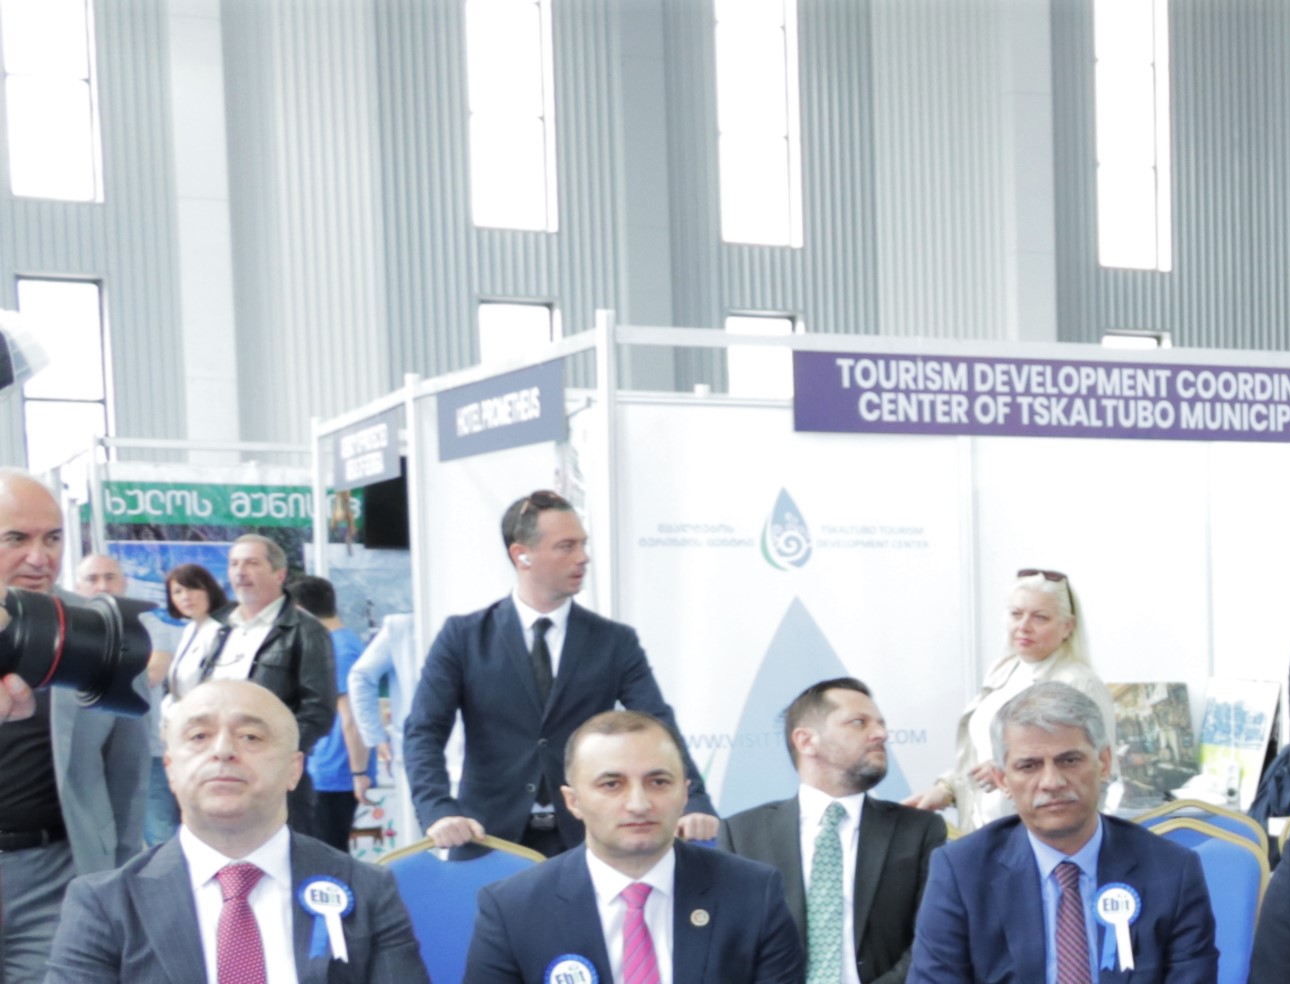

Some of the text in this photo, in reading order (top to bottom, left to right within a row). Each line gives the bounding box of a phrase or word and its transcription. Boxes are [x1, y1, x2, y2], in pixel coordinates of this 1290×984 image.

[836, 357, 968, 393] TOURISM
[974, 362, 1171, 399] DEVELOPMENT
[858, 391, 969, 424] CENTER
[973, 394, 1012, 425] OF
[1016, 396, 1175, 429] TSKALTUBO
